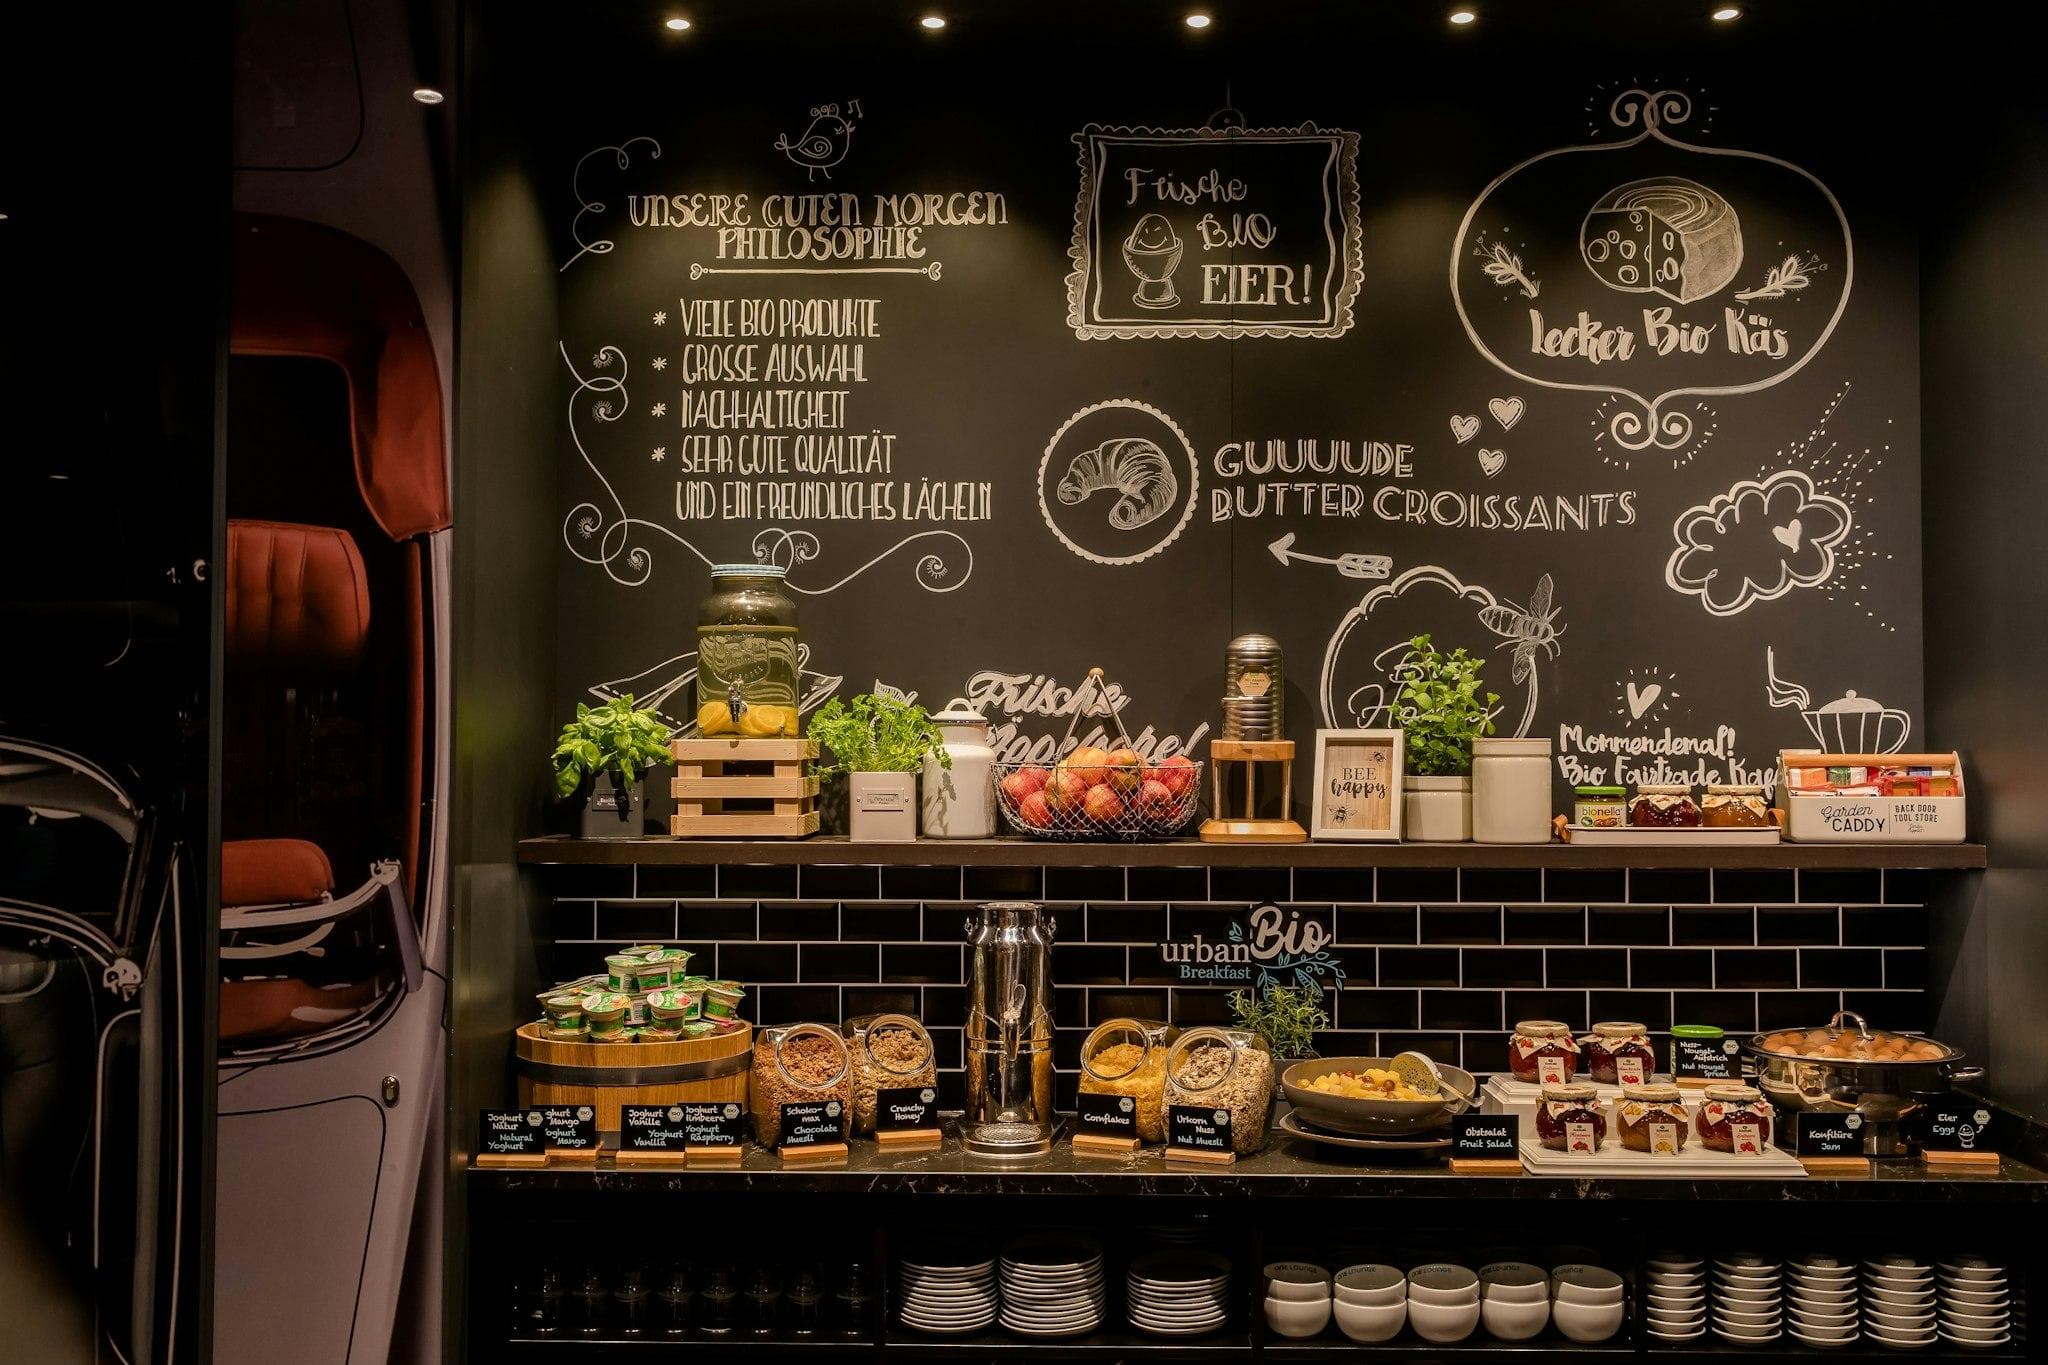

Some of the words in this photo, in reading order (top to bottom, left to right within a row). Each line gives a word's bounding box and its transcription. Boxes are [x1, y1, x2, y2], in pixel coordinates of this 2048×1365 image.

[1124, 167, 1247, 205] Frische
[629, 193, 751, 227] UNSERE
[761, 195, 862, 227] GUTEN
[873, 192, 1009, 227] MORGEN
[715, 226, 927, 260] PHILOSOPHIE
[1199, 263, 1312, 306] EIER!
[680, 298, 735, 338] VIELE
[740, 299, 776, 337] BIO
[779, 299, 881, 338] PRODUKTE
[1528, 308, 1637, 365] Lecker
[1642, 306, 1717, 356] Bio
[1724, 306, 1789, 360] Käs
[682, 344, 758, 384] GROSSE
[764, 344, 868, 382] AUSWAHL
[681, 434, 733, 474] SEHR
[738, 435, 789, 474] GUTE
[794, 429, 896, 475] QUALITÄT
[1213, 439, 1414, 479] GUUUUDE
[676, 481, 716, 521] UND
[723, 481, 751, 520] EIN
[756, 481, 896, 521] FREUNDLICHES
[902, 477, 992, 521] LÄCHELN
[1211, 482, 1365, 524] BUTTER
[1373, 486, 1637, 533] CROISSANTS
[965, 670, 1132, 718] Frische
[1342, 767, 1377, 780] BEE
[1557, 754, 1607, 786] Bio
[1614, 756, 1722, 786] Fairtrade
[1331, 778, 1386, 799] happy
[1820, 804, 1873, 823] Garden
[1895, 804, 1915, 813] BACK
[1917, 804, 1937, 813] DOOR
[1894, 814, 1912, 823] TOOL
[1915, 814, 1938, 823] STORE
[1832, 818, 1886, 833] CADDY
[1160, 935, 1252, 963] urban
[1249, 906, 1331, 960] Bio
[1179, 965, 1251, 979] Breakfast
[545, 1108, 571, 1119] ghurt
[628, 1109, 664, 1120] Joghurt
[889, 1103, 925, 1115] Crunchy
[488, 1113, 523, 1124] Joghurt
[550, 1118, 580, 1128] Mango
[628, 1118, 662, 1126] Vanille
[895, 1112, 921, 1123] Honey
[1083, 1113, 1130, 1125] Cornflakes
[1176, 1115, 1208, 1126] Urkorn
[1937, 1113, 1958, 1122] Eier
[492, 1122, 519, 1130] Natur
[686, 1124, 720, 1136] Yoghurt
[793, 1124, 839, 1135] Chocolate
[1465, 1126, 1507, 1137] Obstsalat
[1932, 1125, 1955, 1136] Eggs
[499, 1133, 534, 1142] Natural
[545, 1128, 576, 1139] oghurt
[648, 1129, 684, 1140] Yoghurt
[690, 1134, 734, 1145] Raspberry
[786, 1134, 815, 1144] Muesli
[1809, 1129, 1853, 1141] Konfitüre
[488, 1141, 524, 1152] Yoghurt
[556, 1138, 587, 1147] Mango
[634, 1137, 666, 1147] Vanilla
[1177, 1135, 1193, 1144] Nut
[1195, 1136, 1224, 1147] Muesli
[1460, 1139, 1484, 1148] Fruit
[1486, 1138, 1513, 1148] Salad
